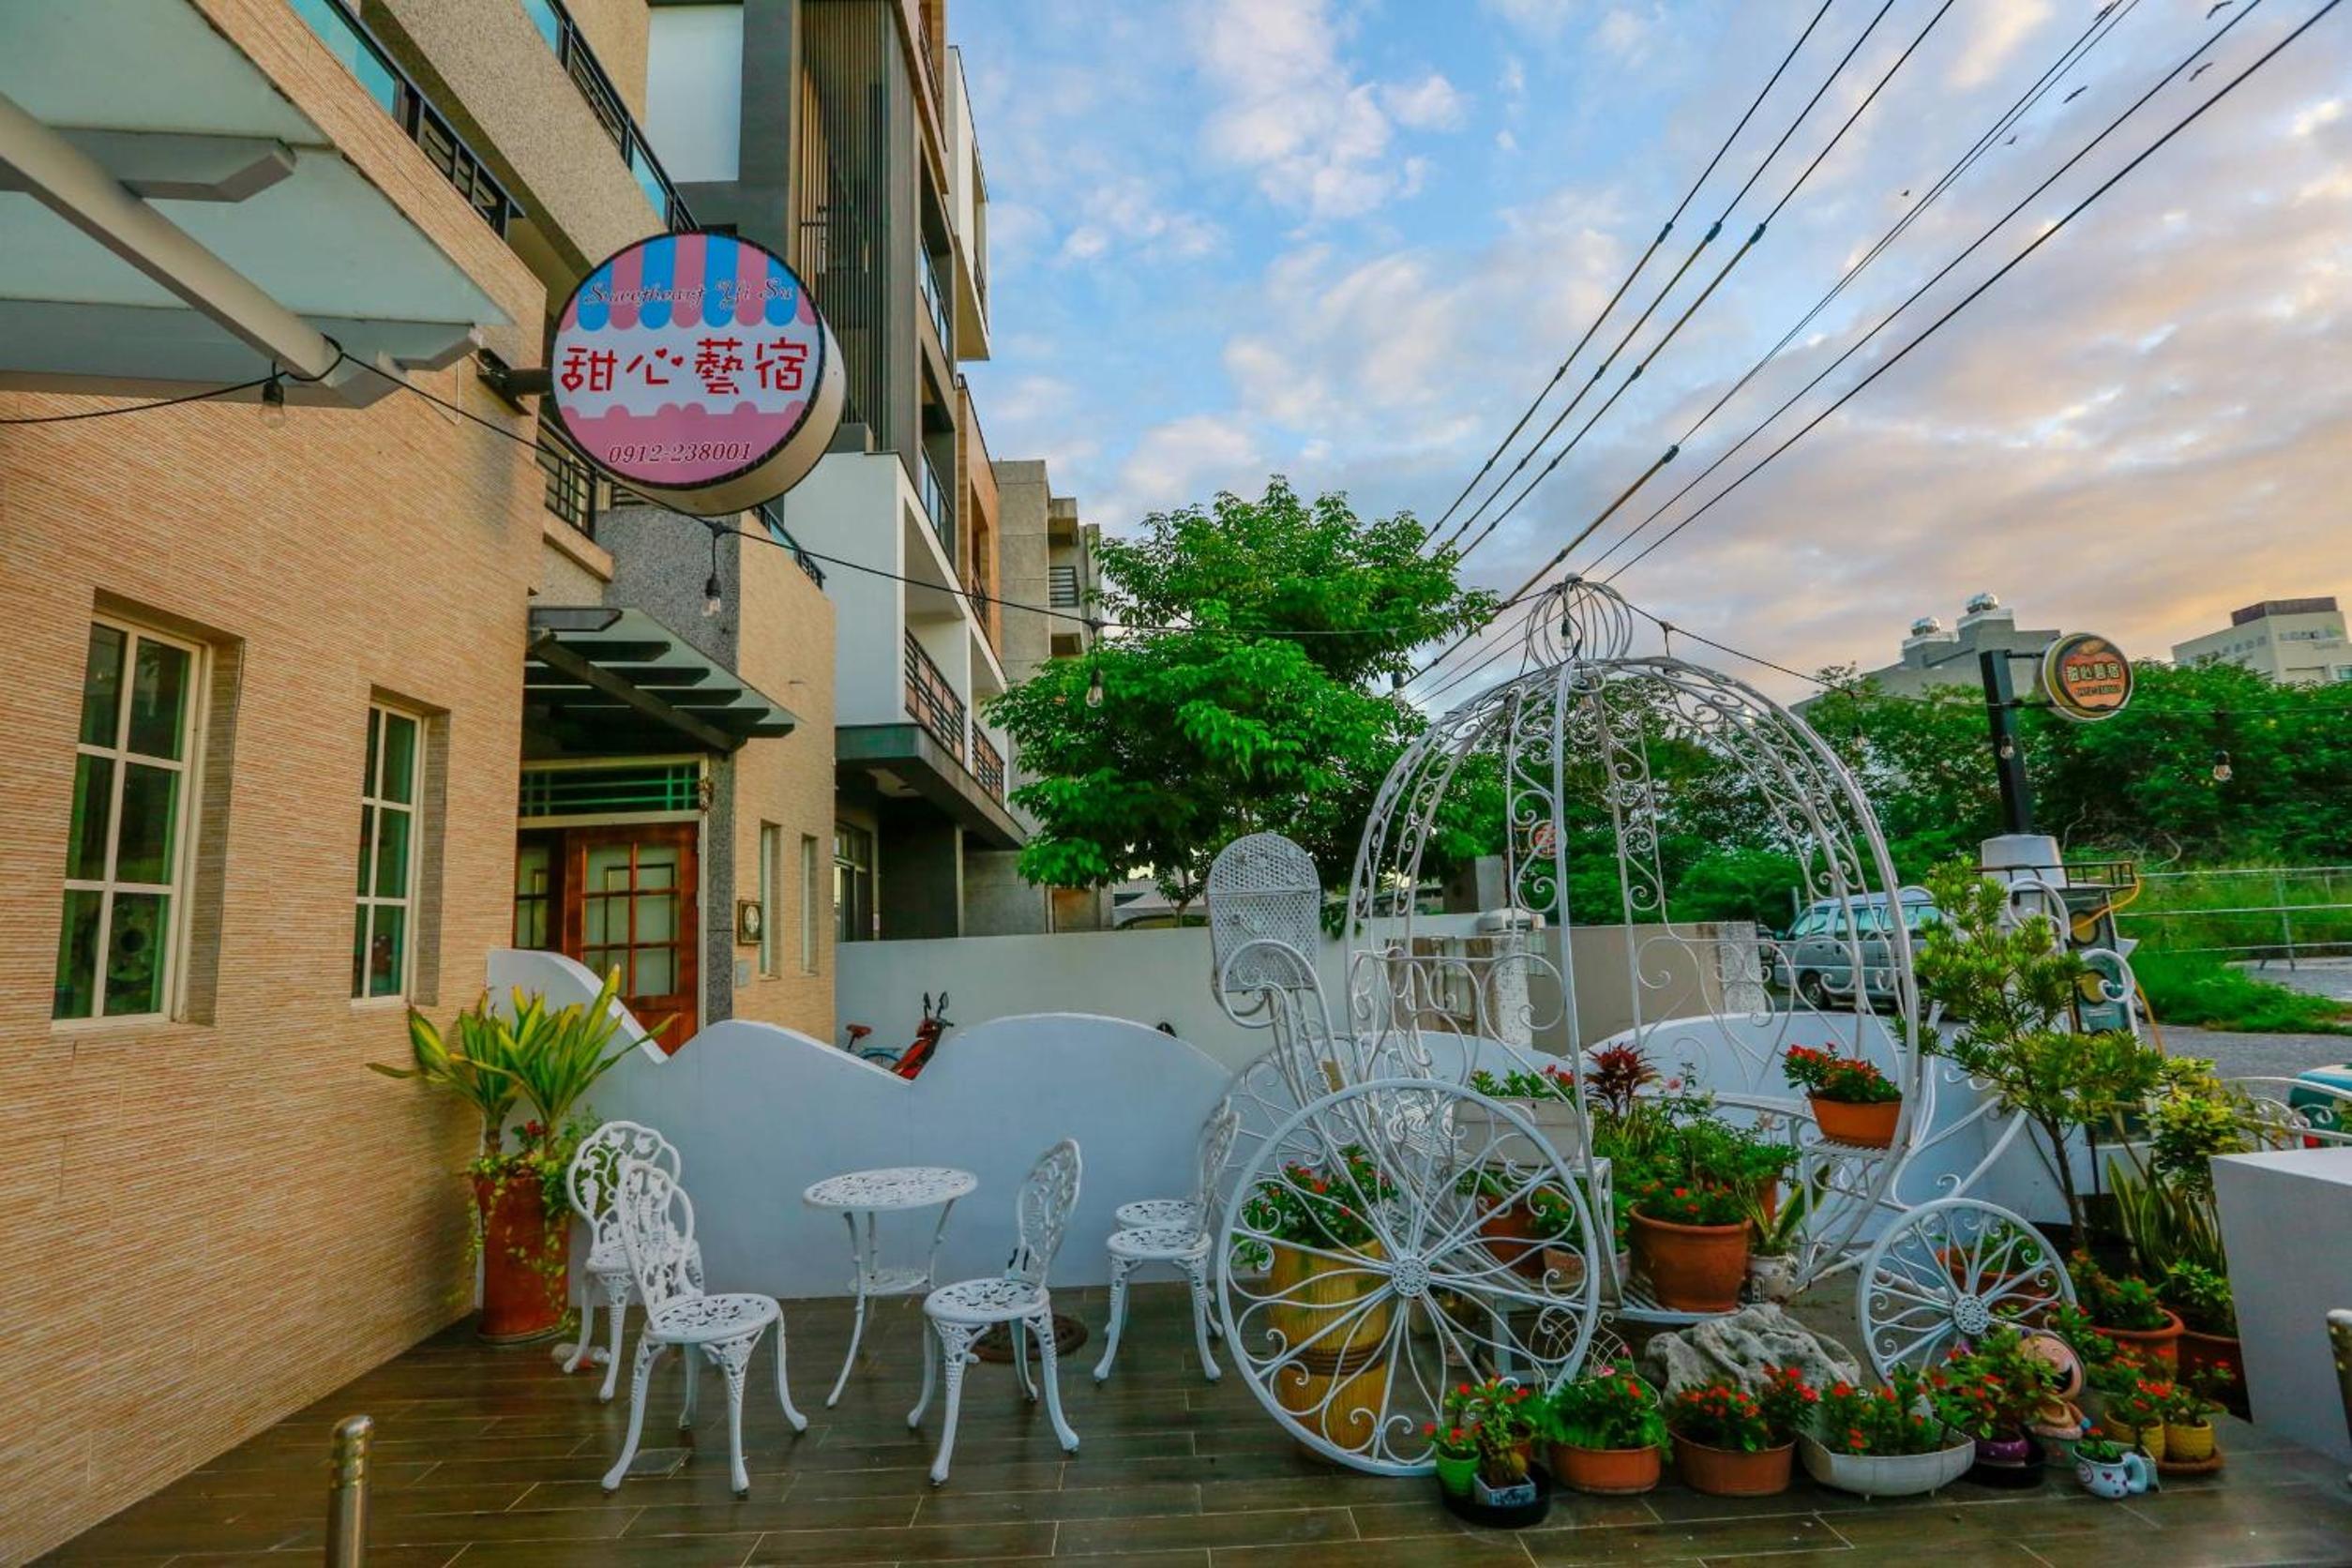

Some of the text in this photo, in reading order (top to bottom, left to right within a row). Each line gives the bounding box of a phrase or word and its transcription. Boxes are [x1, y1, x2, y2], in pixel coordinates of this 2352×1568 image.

[757, 277, 792, 300] Su
[560, 337, 810, 395] 甜心藝宿
[609, 442, 751, 464] 0912-238001
